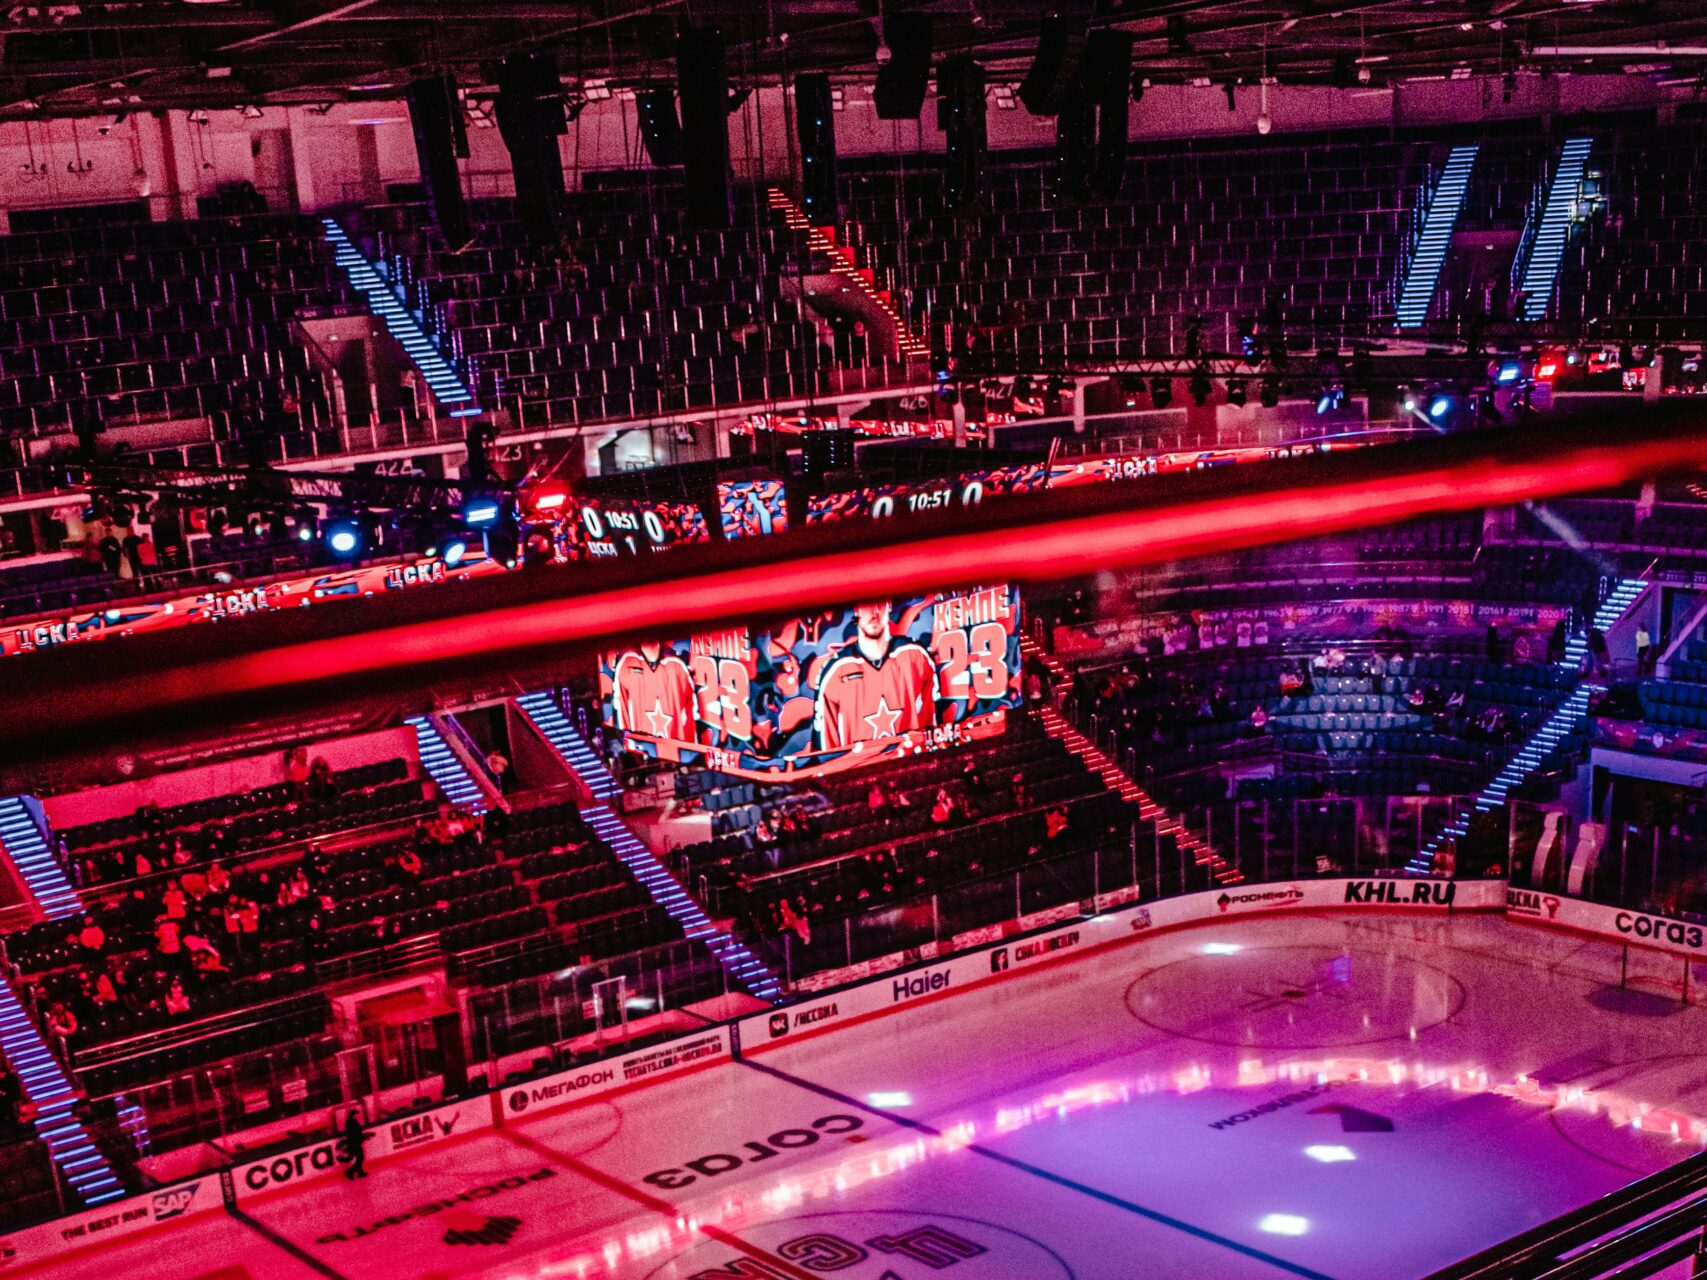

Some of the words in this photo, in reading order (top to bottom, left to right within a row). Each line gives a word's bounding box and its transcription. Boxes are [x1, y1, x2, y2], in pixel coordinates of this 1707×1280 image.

[909, 490, 952, 512] 10:51
[582, 507, 603, 539] 0
[643, 511, 665, 543] 0
[587, 541, 618, 557] ЦСКА
[388, 561, 444, 588] ЦСКА
[208, 590, 270, 618] ЦСКА
[933, 584, 1010, 632] КЕМПЕ
[16, 622, 80, 649] ЦСКА
[937, 622, 1008, 700] 23
[695, 655, 752, 741] 23
[1344, 881, 1456, 905] KHL.RU
[893, 969, 951, 1002] Haier
[390, 1115, 434, 1144] ЦСКА
[61, 1225, 86, 1241] THE
[87, 1214, 119, 1234] BEST
[122, 1207, 148, 1224] RUN
[154, 1189, 193, 1216] SAP
